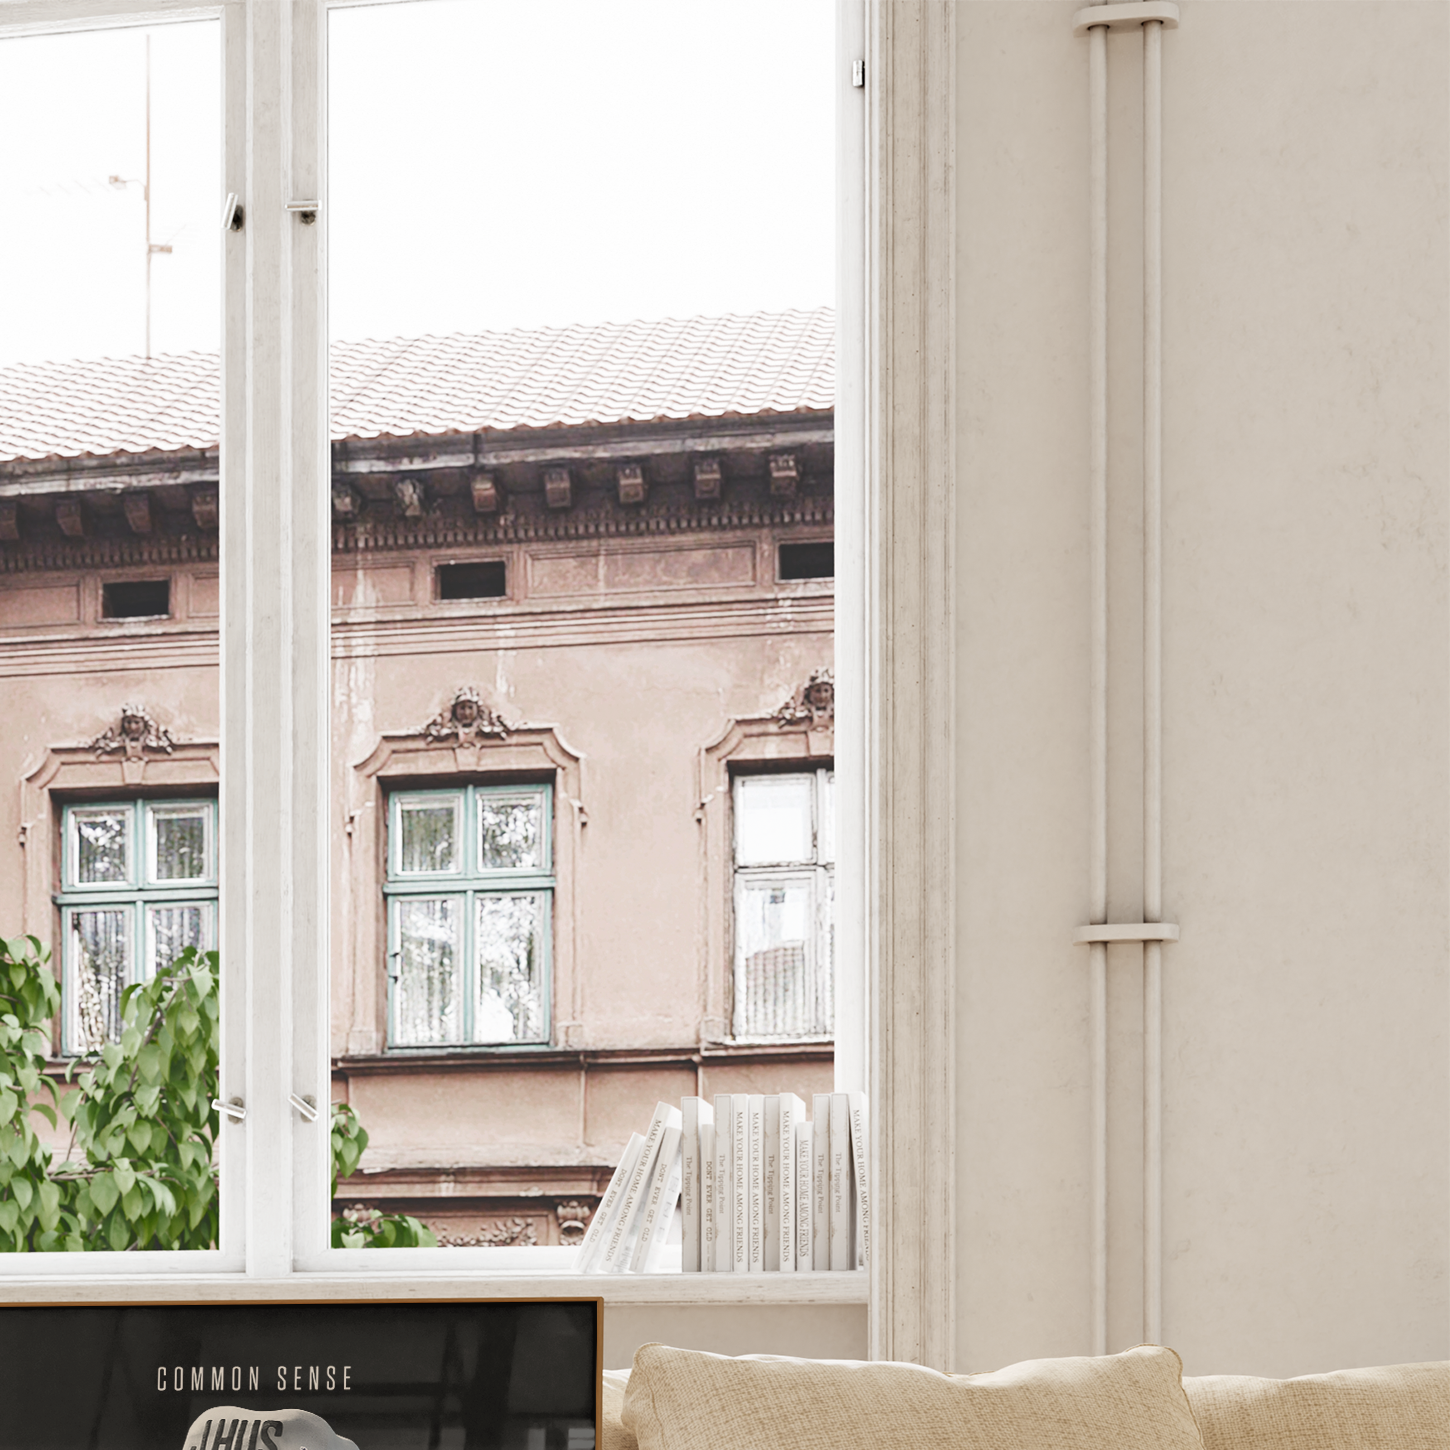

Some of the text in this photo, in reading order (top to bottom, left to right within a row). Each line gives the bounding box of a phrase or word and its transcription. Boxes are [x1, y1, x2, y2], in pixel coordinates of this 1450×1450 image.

[736, 1138, 744, 1162] YOUR
[768, 1154, 776, 1168] The
[835, 1153, 843, 1166] The
[684, 1171, 693, 1197] Tipping
[706, 1161, 715, 1181] DONT
[717, 1169, 726, 1195] Tipping
[736, 1164, 744, 1190] HOME
[767, 1170, 775, 1196] Tipping
[816, 1169, 825, 1195] Tipping
[834, 1168, 842, 1194] Tipping
[606, 1119, 662, 1262] MAKE YOUR HOME AMONG FRIENDS
[752, 1112, 760, 1264] MAKE YOUR HOME AMONG FRIENDS
[782, 1111, 790, 1263] MAKE YOUR HOME AMONG FRIENDS
[799, 1140, 809, 1258] MAKE YOUR HOME AMONG FRIENDS
[589, 1168, 628, 1243] DONT EVER GET OLD
[641, 1163, 668, 1242] DONT EVER GET OLD
[736, 1192, 744, 1225] AMONG
[736, 1227, 744, 1263] FRIENDS
[157, 1365, 351, 1391] COMMON SENSE
